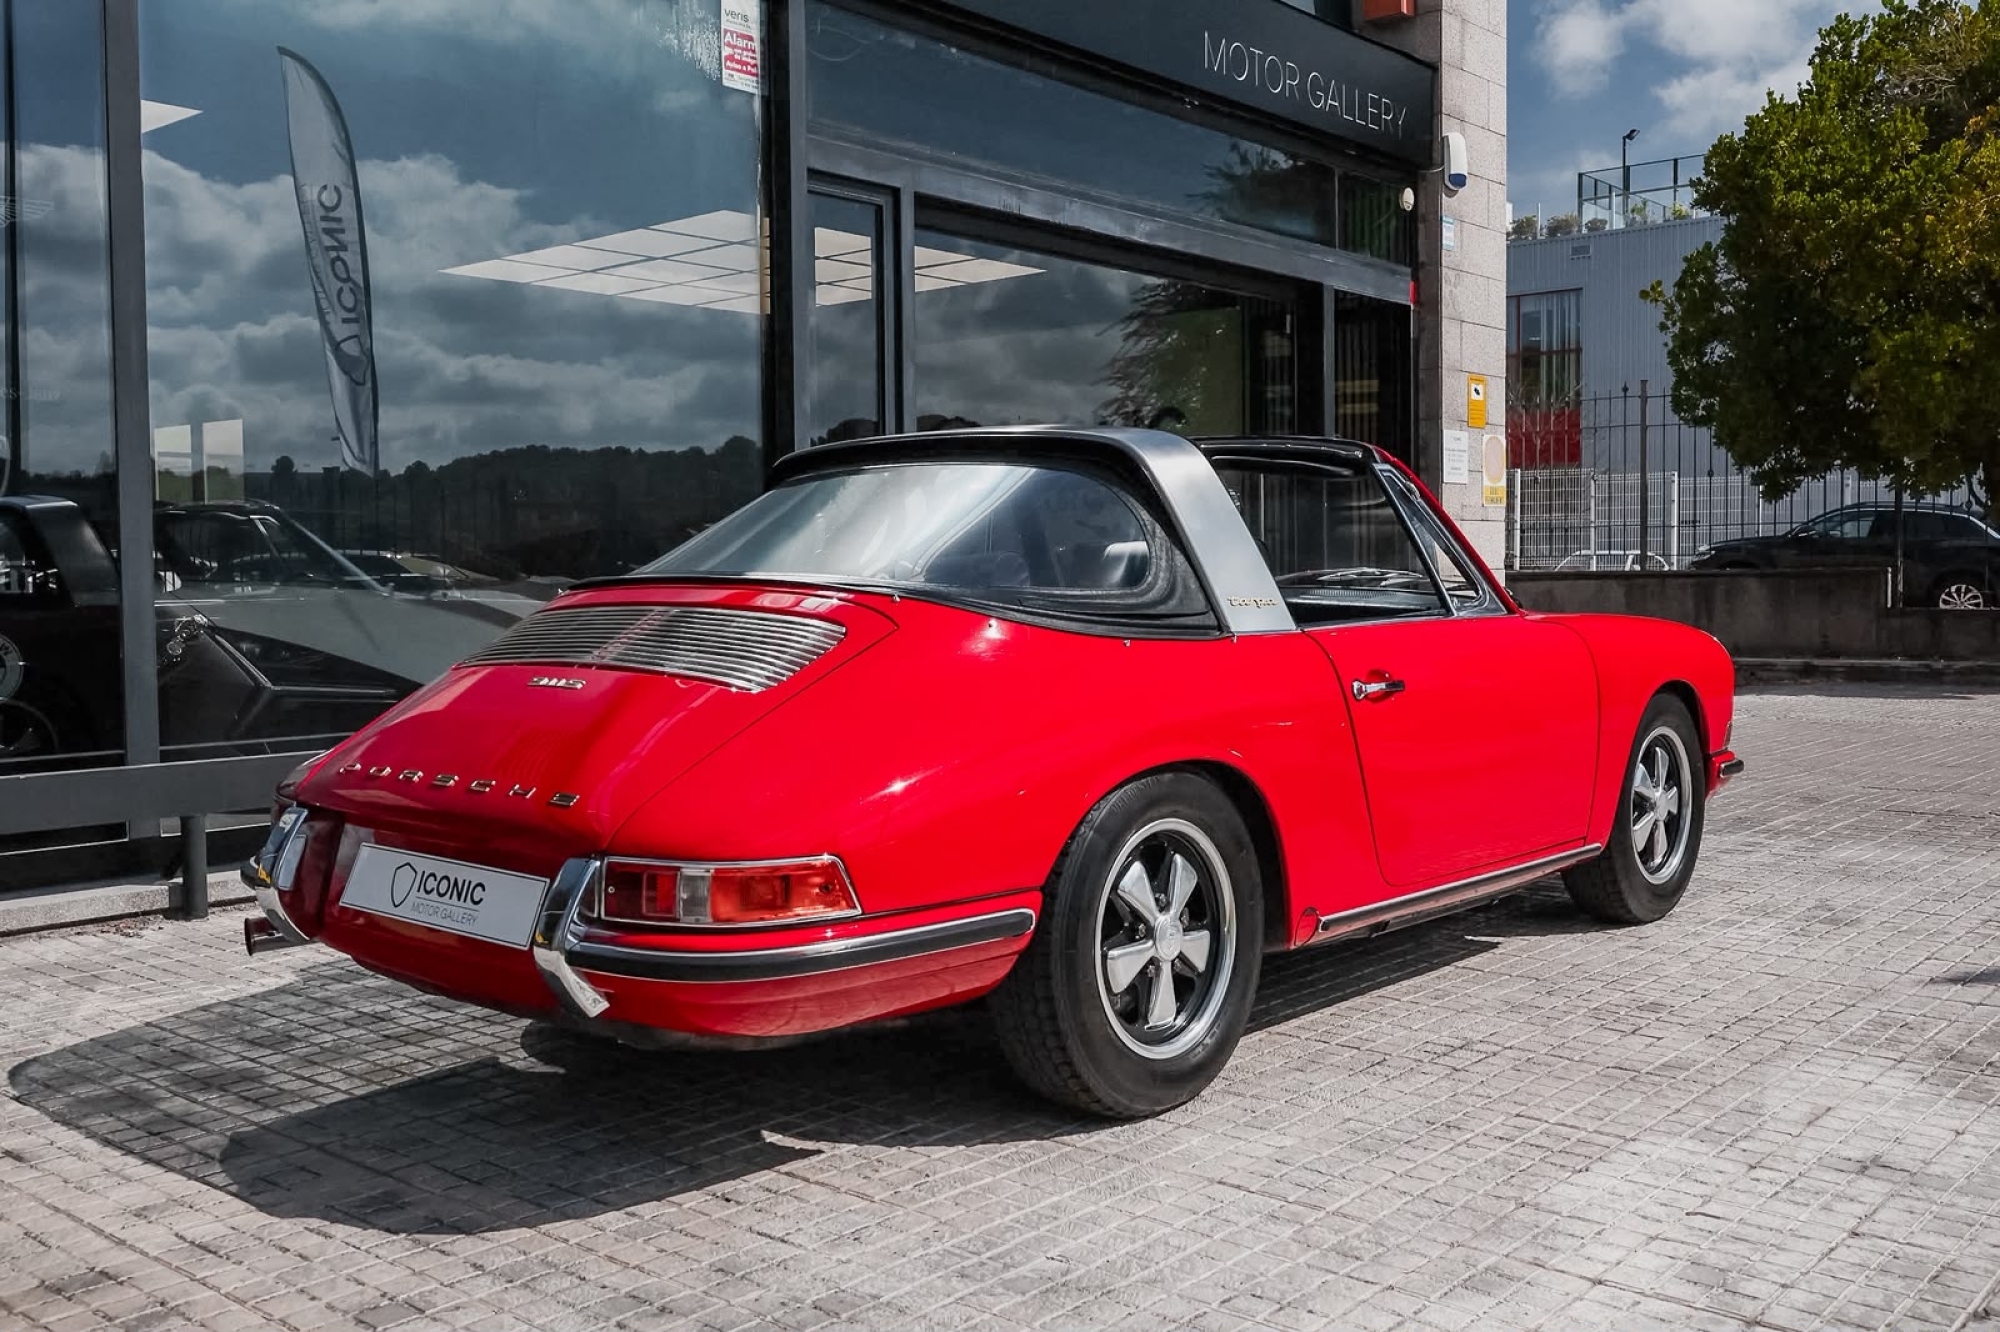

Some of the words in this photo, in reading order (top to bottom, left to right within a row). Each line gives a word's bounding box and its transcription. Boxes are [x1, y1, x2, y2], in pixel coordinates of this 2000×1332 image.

[1204, 30, 1300, 100] MOTOR
[1306, 71, 1407, 140] GALLERY
[339, 761, 581, 807] PORSCHE
[416, 870, 486, 906] ICONIC
[410, 901, 441, 917] MOTOR
[440, 907, 480, 926] GALLERY
